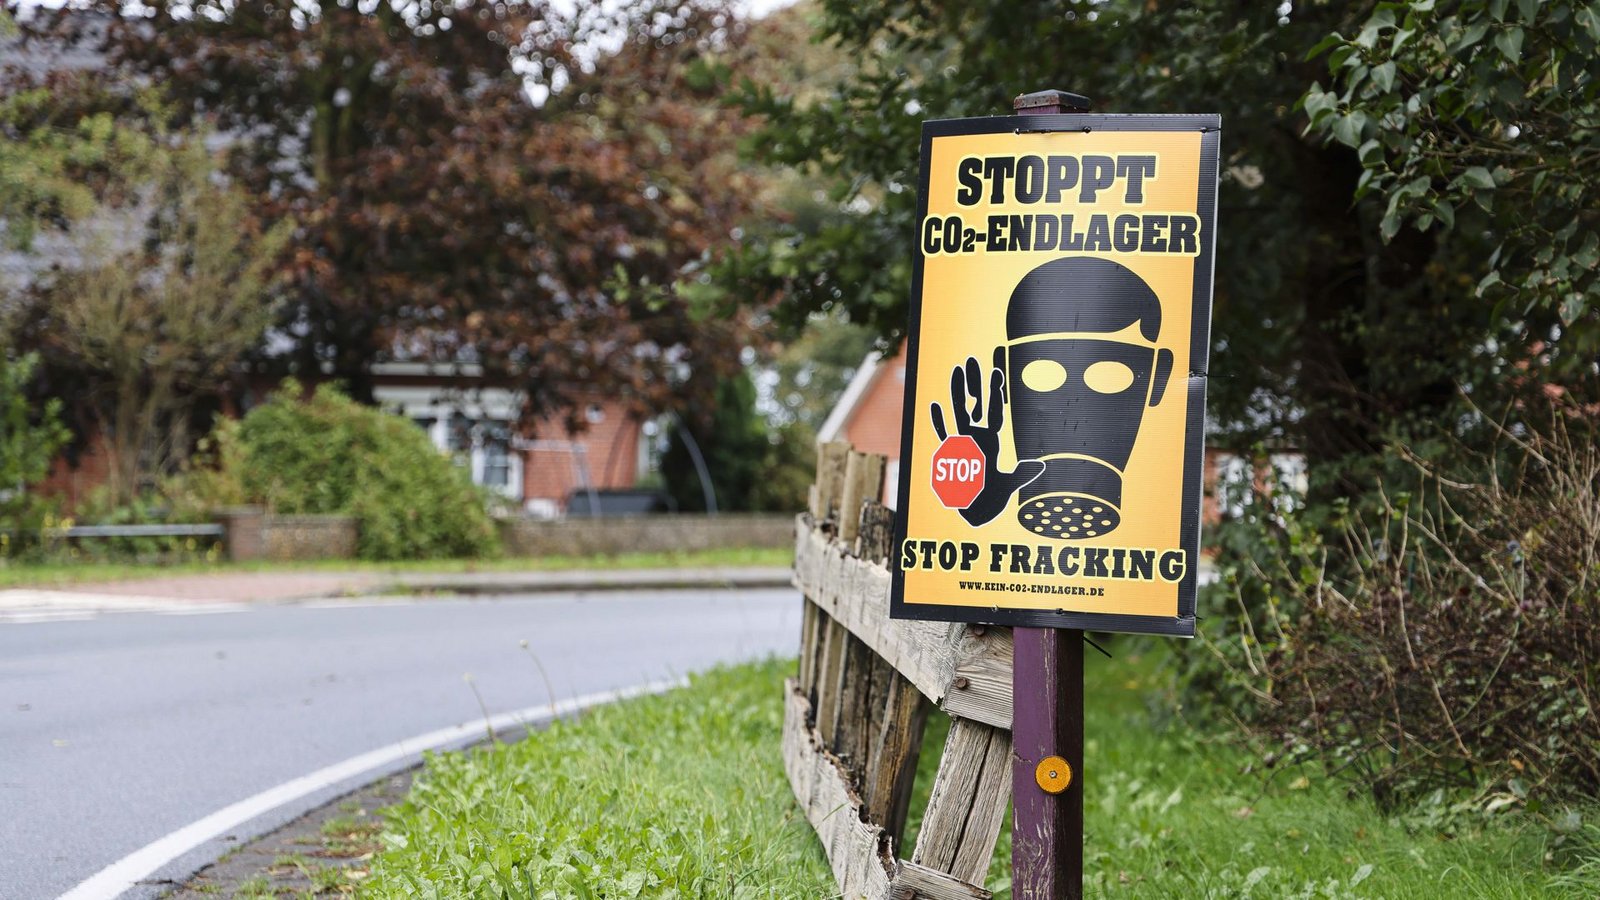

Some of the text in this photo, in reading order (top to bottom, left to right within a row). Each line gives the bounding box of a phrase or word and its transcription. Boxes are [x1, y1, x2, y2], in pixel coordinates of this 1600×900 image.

[957, 155, 1156, 205] STOPPT
[936, 458, 981, 482] STOP
[903, 540, 1185, 580] STOP FRACKING
[959, 581, 1105, 597] WWW.KEIN-CO2-ENDLAGER.DE
